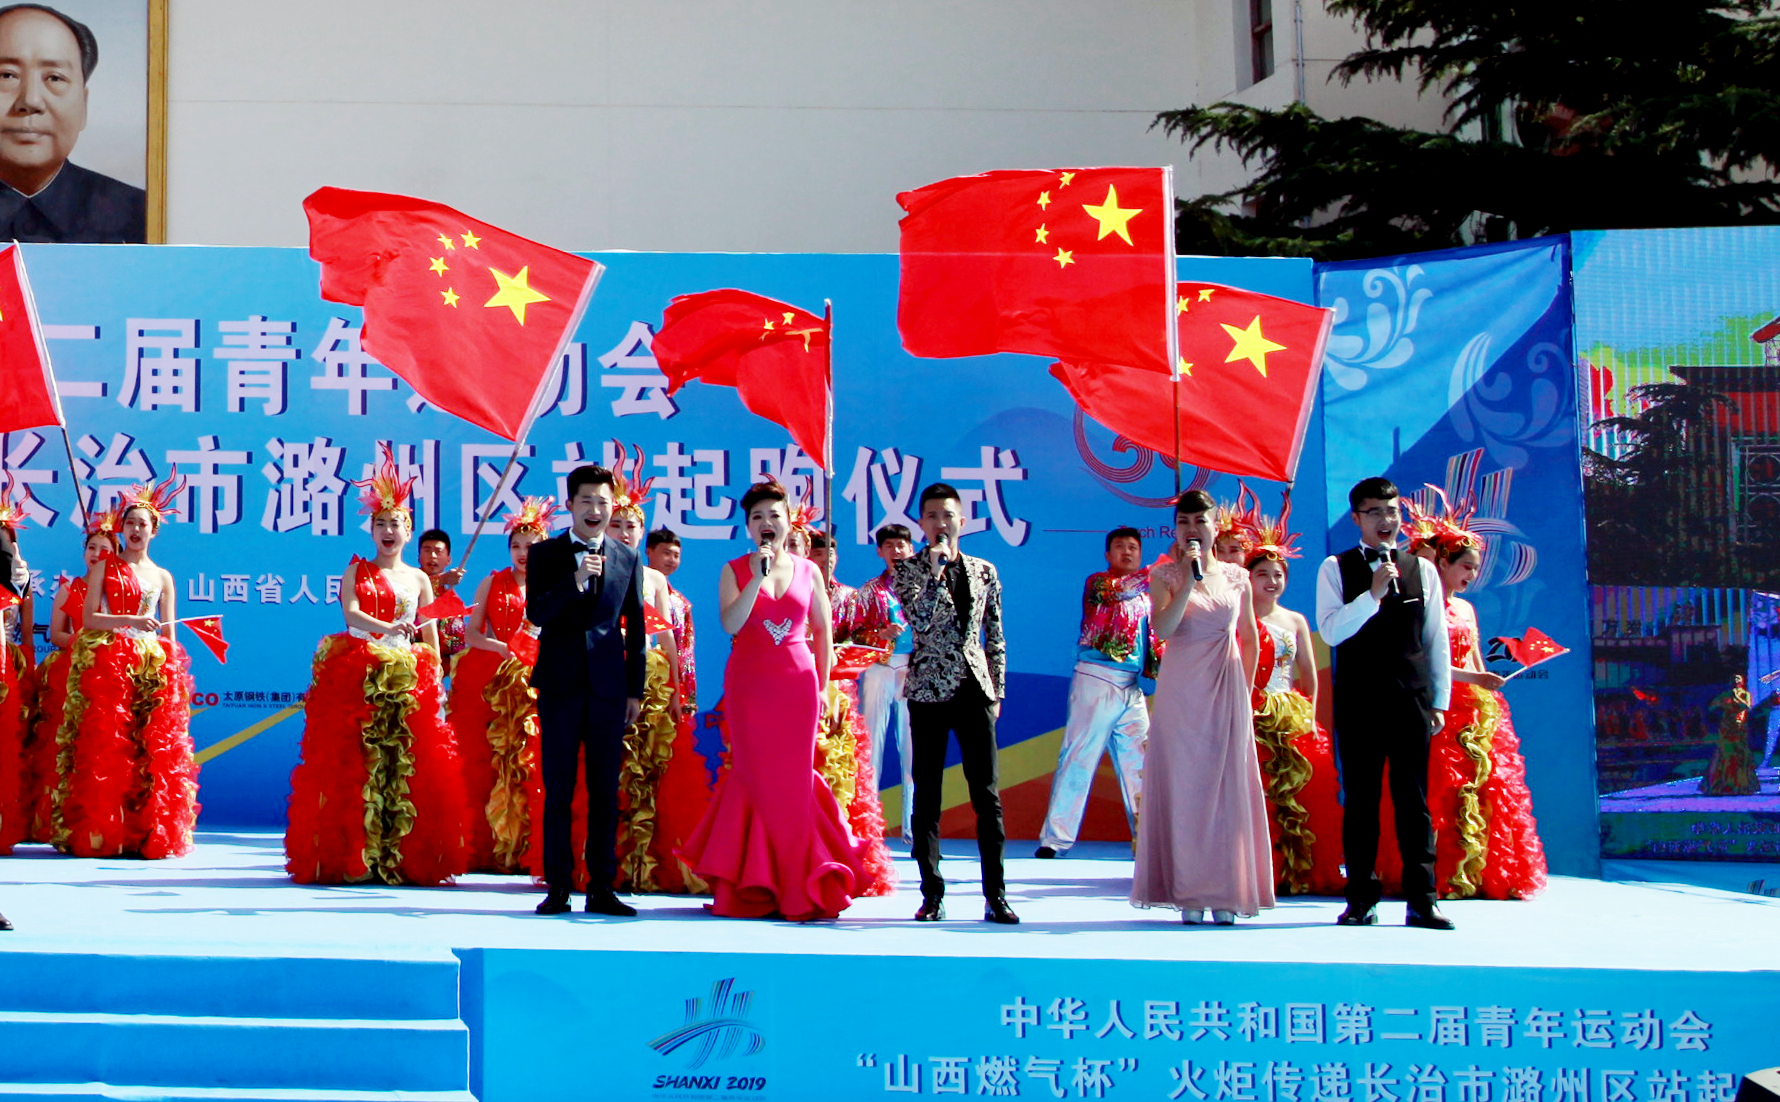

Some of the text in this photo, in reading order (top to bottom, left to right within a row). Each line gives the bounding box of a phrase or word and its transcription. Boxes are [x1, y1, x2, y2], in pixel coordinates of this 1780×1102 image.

[1000, 996, 1714, 1052] 中华人民共和国第二届青年运动会
[653, 1075, 767, 1091] SHANXI 2019
[856, 1052, 1139, 1098] “山西燃气杯”
